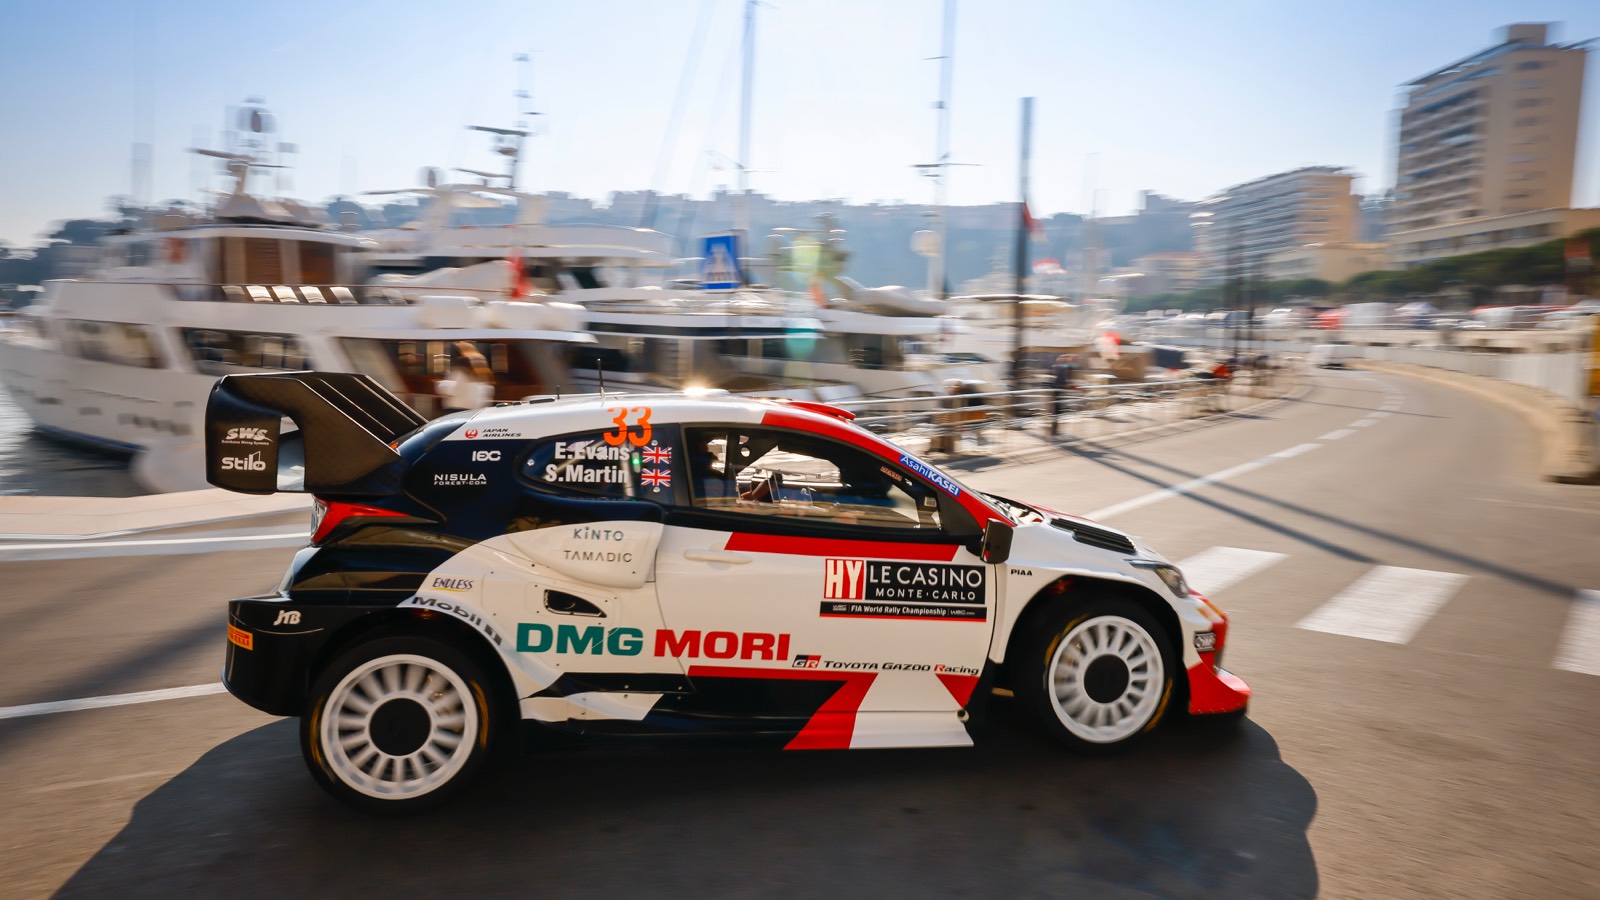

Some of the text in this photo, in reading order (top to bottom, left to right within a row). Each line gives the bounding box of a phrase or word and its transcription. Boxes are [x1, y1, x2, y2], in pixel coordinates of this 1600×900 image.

[226, 427, 274, 442] SWS
[603, 405, 652, 447] 33
[555, 442, 630, 460] E.Evans
[221, 450, 266, 471] Stilo
[434, 473, 487, 481] NISULA
[544, 464, 627, 483] S.Martin
[825, 559, 983, 599] HY LE CASINO
[1010, 568, 1033, 576] PIAA
[432, 577, 474, 590] ENDLESS
[411, 596, 482, 626] Mobil
[850, 604, 862, 612] FIA
[863, 605, 883, 613] World
[884, 606, 901, 615] Rally
[901, 607, 947, 617] Championship
[516, 622, 791, 661] DMG MORI
[823, 660, 879, 670] TOYOTA
[882, 662, 931, 672] GAZOO
[933, 664, 980, 676] Racing
